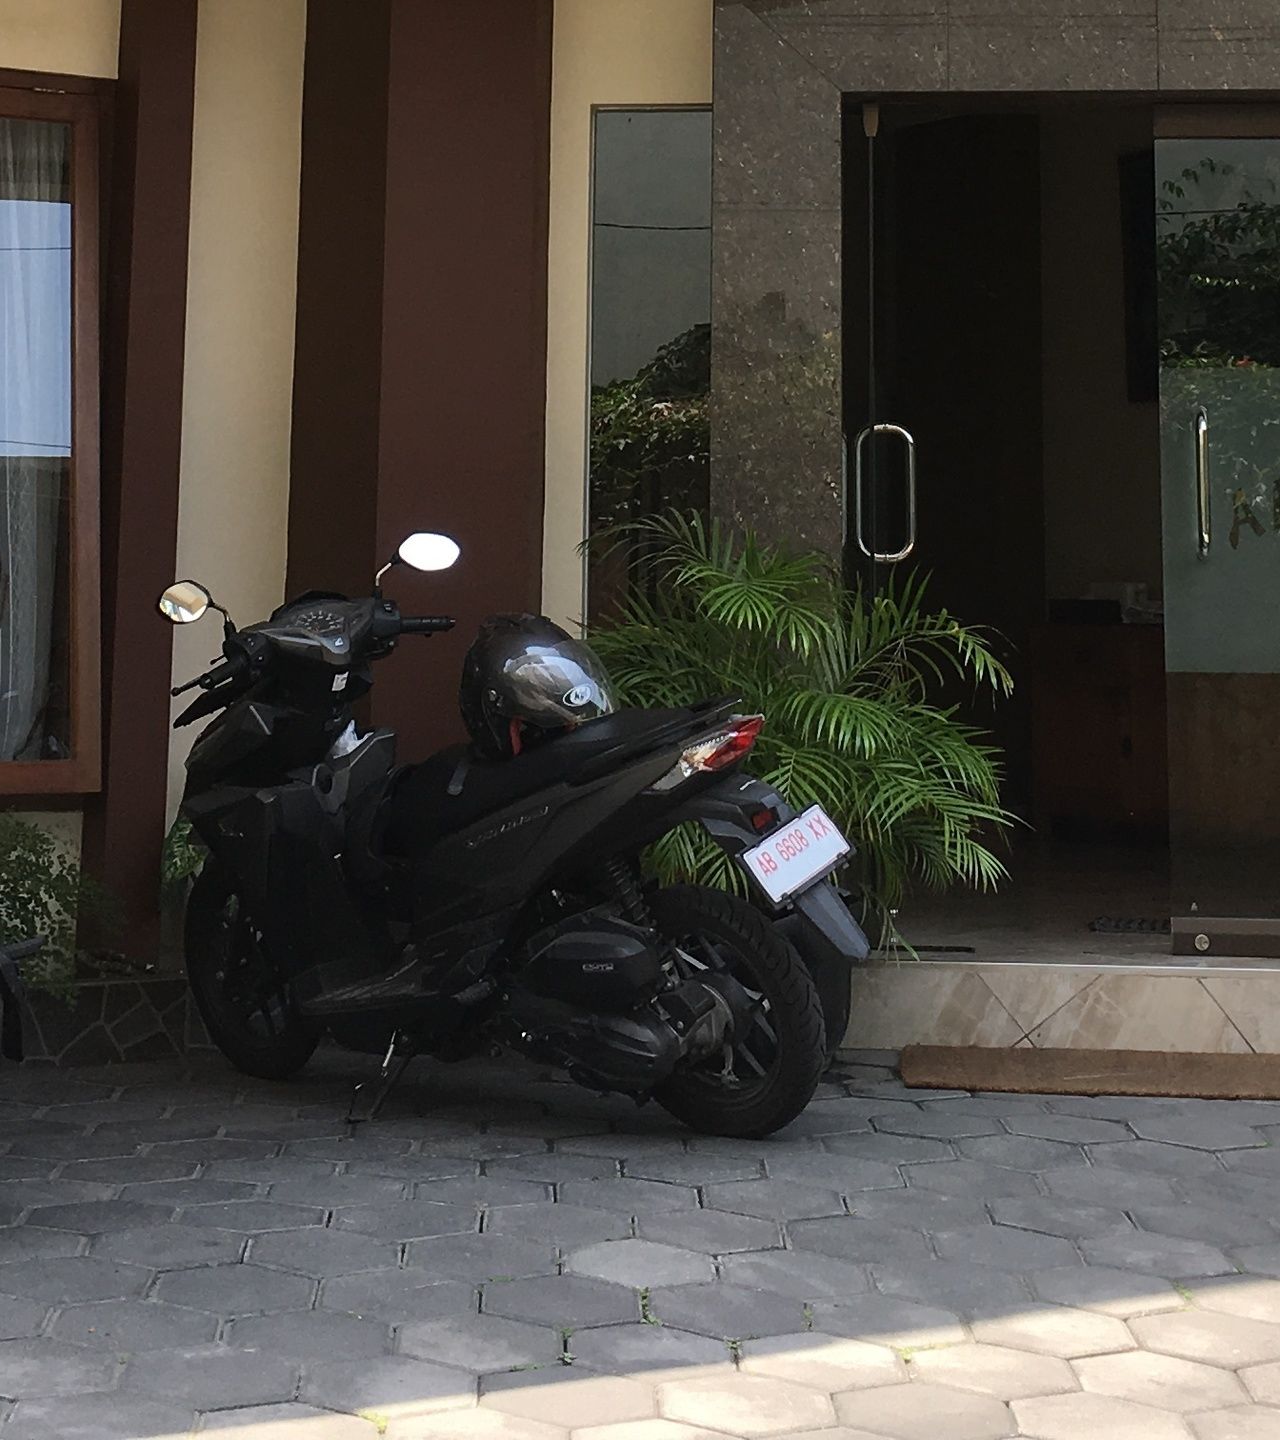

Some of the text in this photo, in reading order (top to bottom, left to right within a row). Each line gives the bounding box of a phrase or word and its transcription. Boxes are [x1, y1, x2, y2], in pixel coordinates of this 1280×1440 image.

[756, 814, 832, 876] AB 6608 XX
